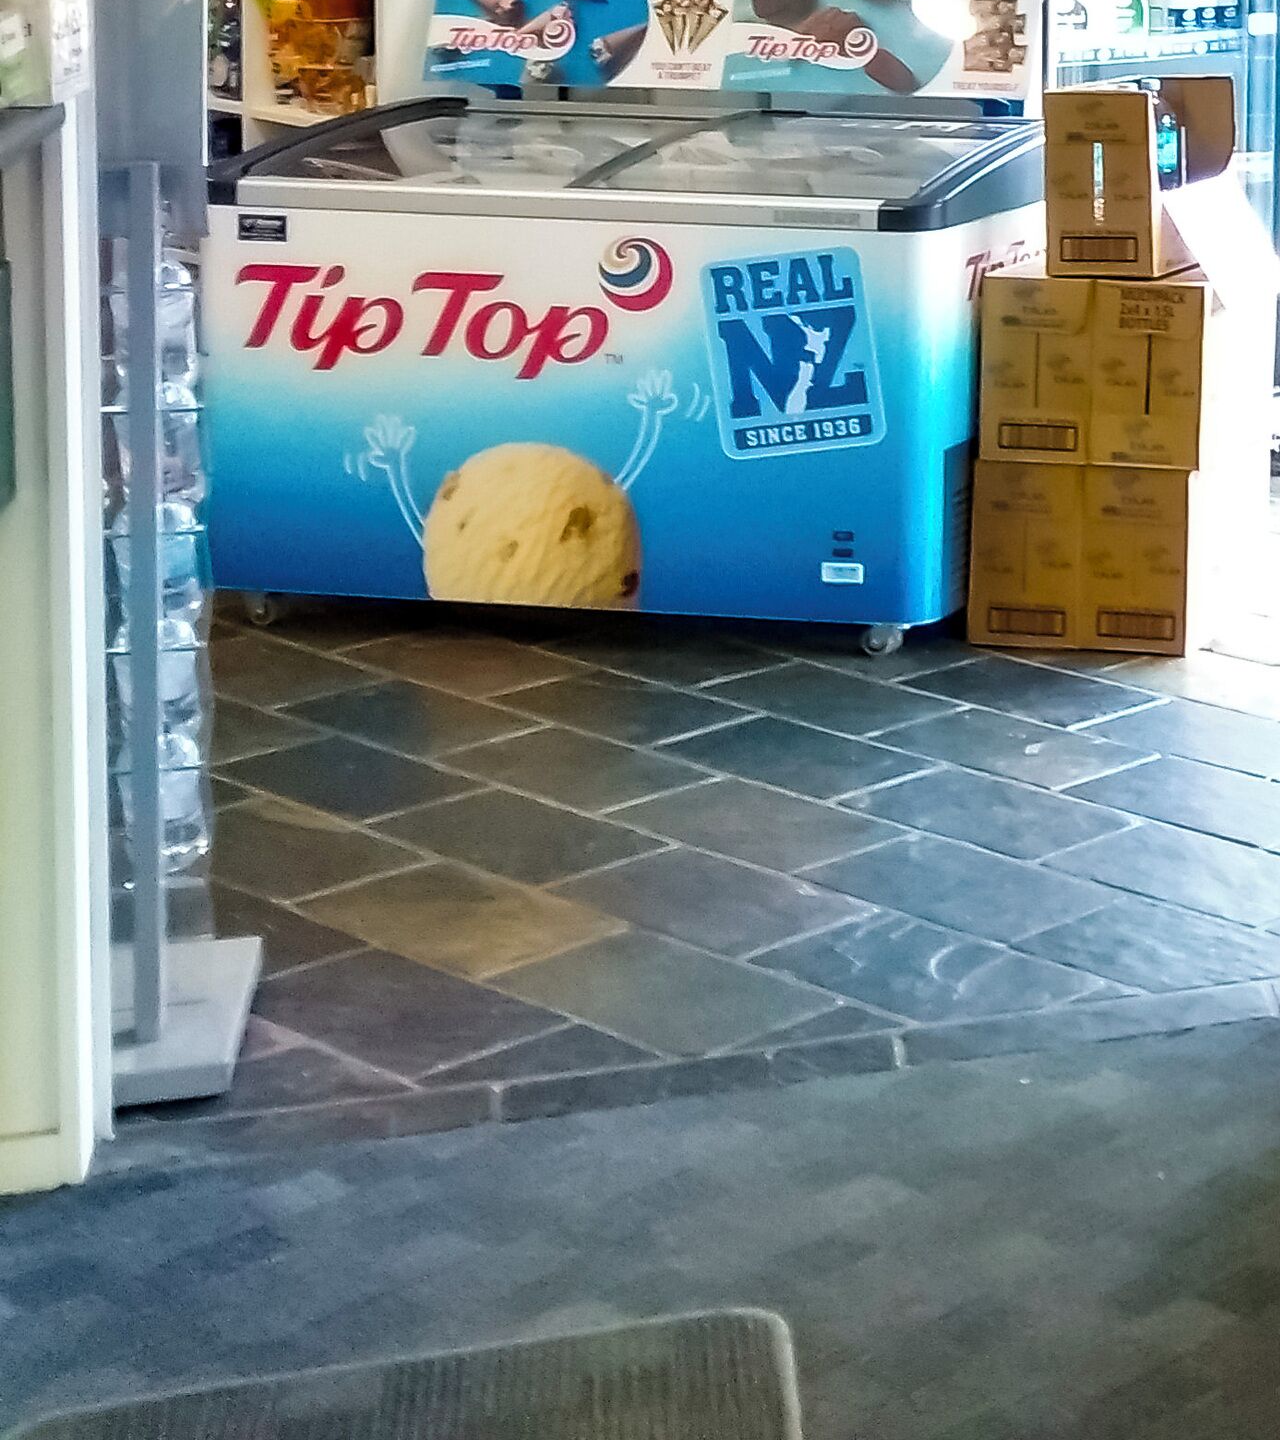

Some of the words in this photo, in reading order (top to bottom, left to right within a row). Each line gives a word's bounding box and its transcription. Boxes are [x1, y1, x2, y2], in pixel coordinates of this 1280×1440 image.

[449, 27, 486, 53] Tip
[490, 28, 538, 53] Top
[748, 35, 787, 61] Tip
[790, 37, 838, 62] Top
[710, 254, 854, 314] REAL
[236, 263, 404, 371] Tip
[412, 271, 609, 380] Top
[718, 305, 869, 419] NZ
[746, 425, 807, 447] SINCE
[814, 418, 861, 439] 1936
